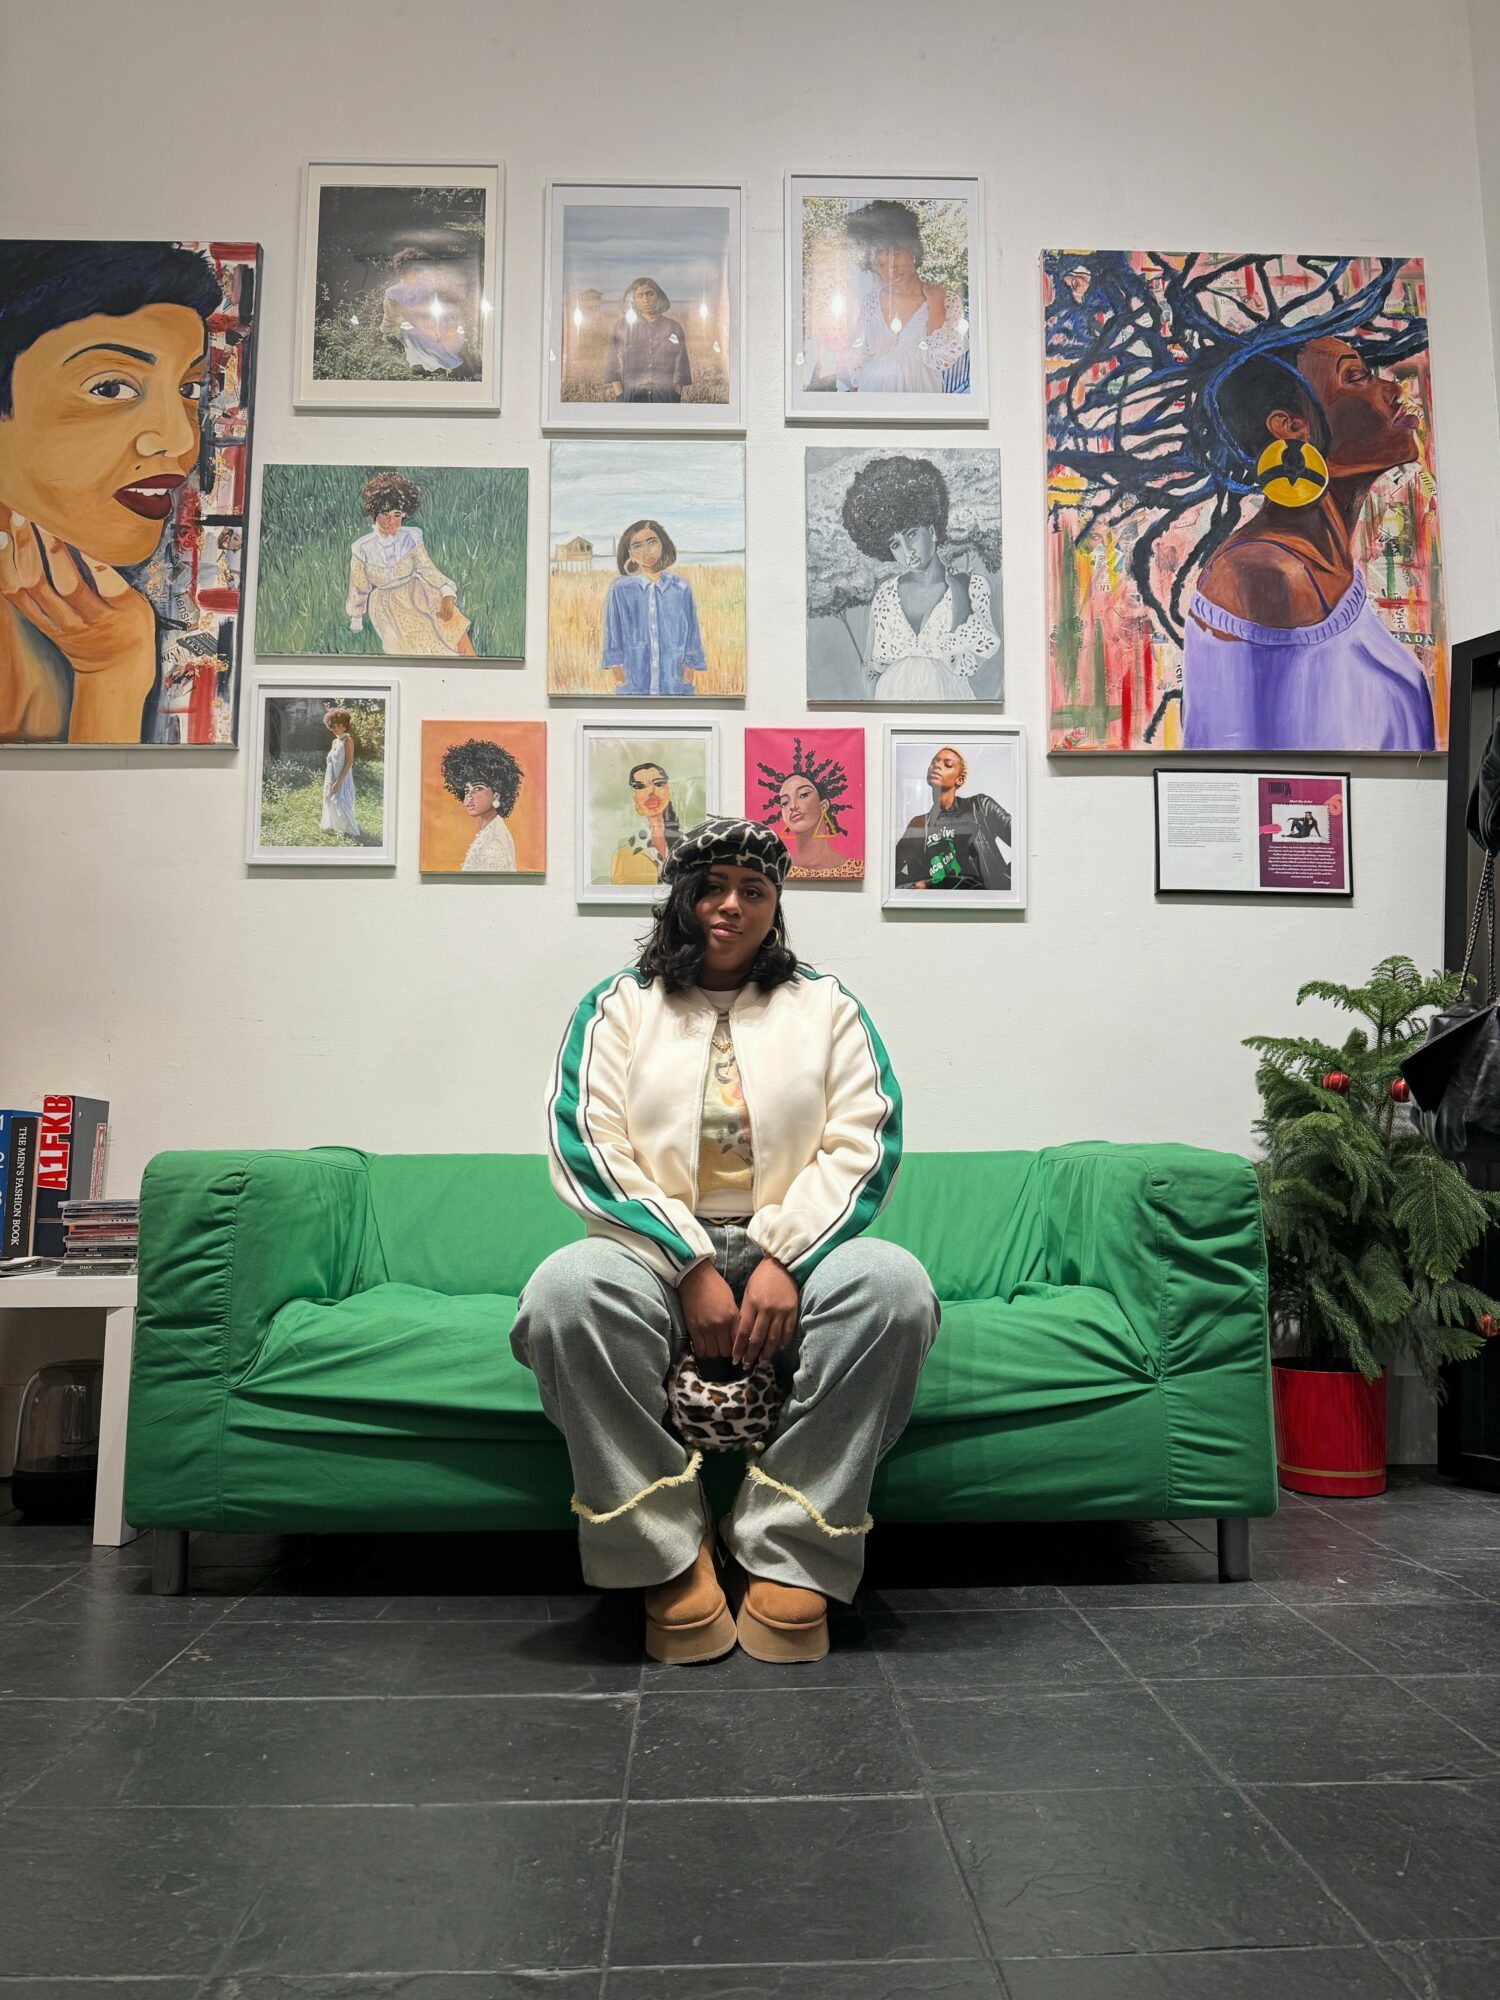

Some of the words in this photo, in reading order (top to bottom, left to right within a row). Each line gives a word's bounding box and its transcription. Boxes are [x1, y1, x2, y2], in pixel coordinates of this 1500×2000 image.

[18, 1126, 28, 1146] THE
[38, 1095, 73, 1190] A1FKB
[16, 1147, 26, 1178] MEN'S
[13, 1178, 24, 1218] FASHION
[10, 1219, 21, 1246] BOOK
